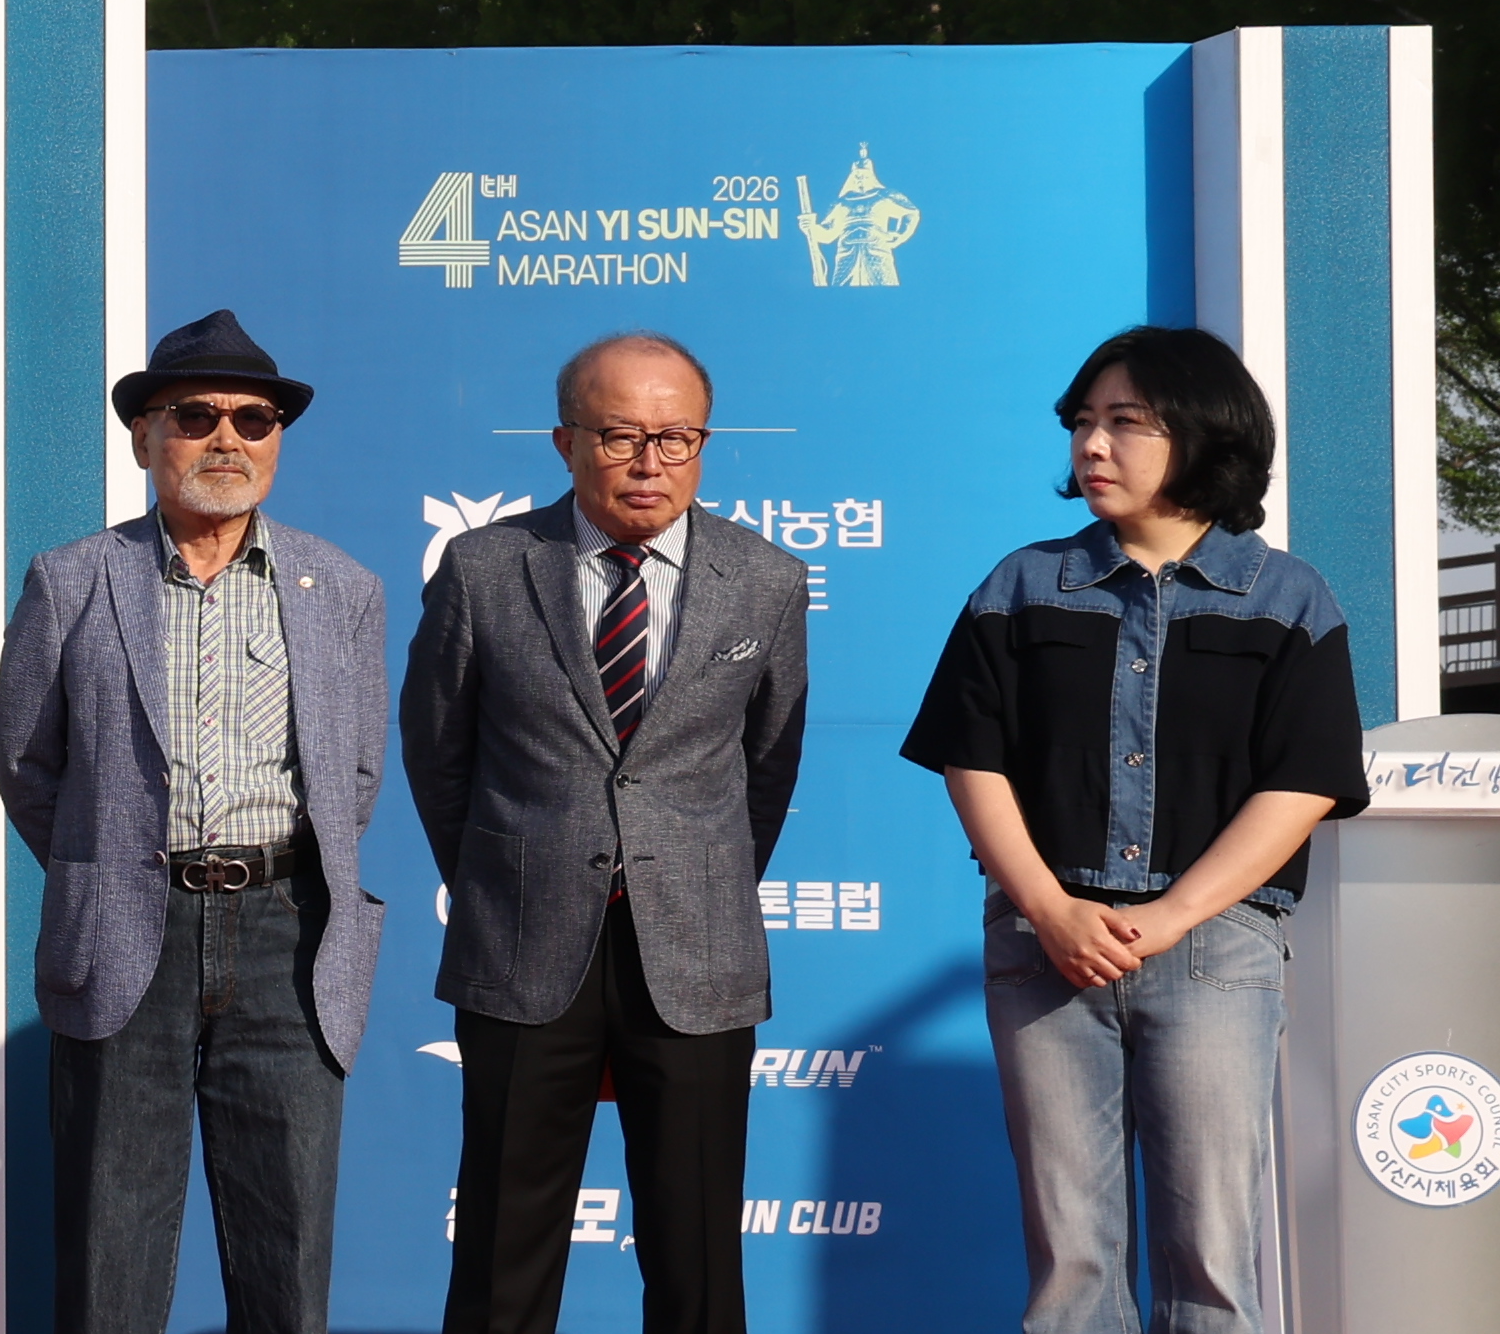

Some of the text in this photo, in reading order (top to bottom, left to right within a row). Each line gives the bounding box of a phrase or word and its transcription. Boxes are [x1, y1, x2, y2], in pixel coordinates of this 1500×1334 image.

[712, 175, 780, 202] 2026
[496, 206, 779, 242] ASAN YI SUN-SIN
[497, 251, 688, 286] MARATHON
[1367, 1099, 1384, 1140] ASAN
[1380, 1070, 1410, 1098] CITY
[1415, 1064, 1477, 1087] SPORTS
[1375, 1150, 1499, 1199] 아산시체육회
[788, 1200, 882, 1235] CLUB
